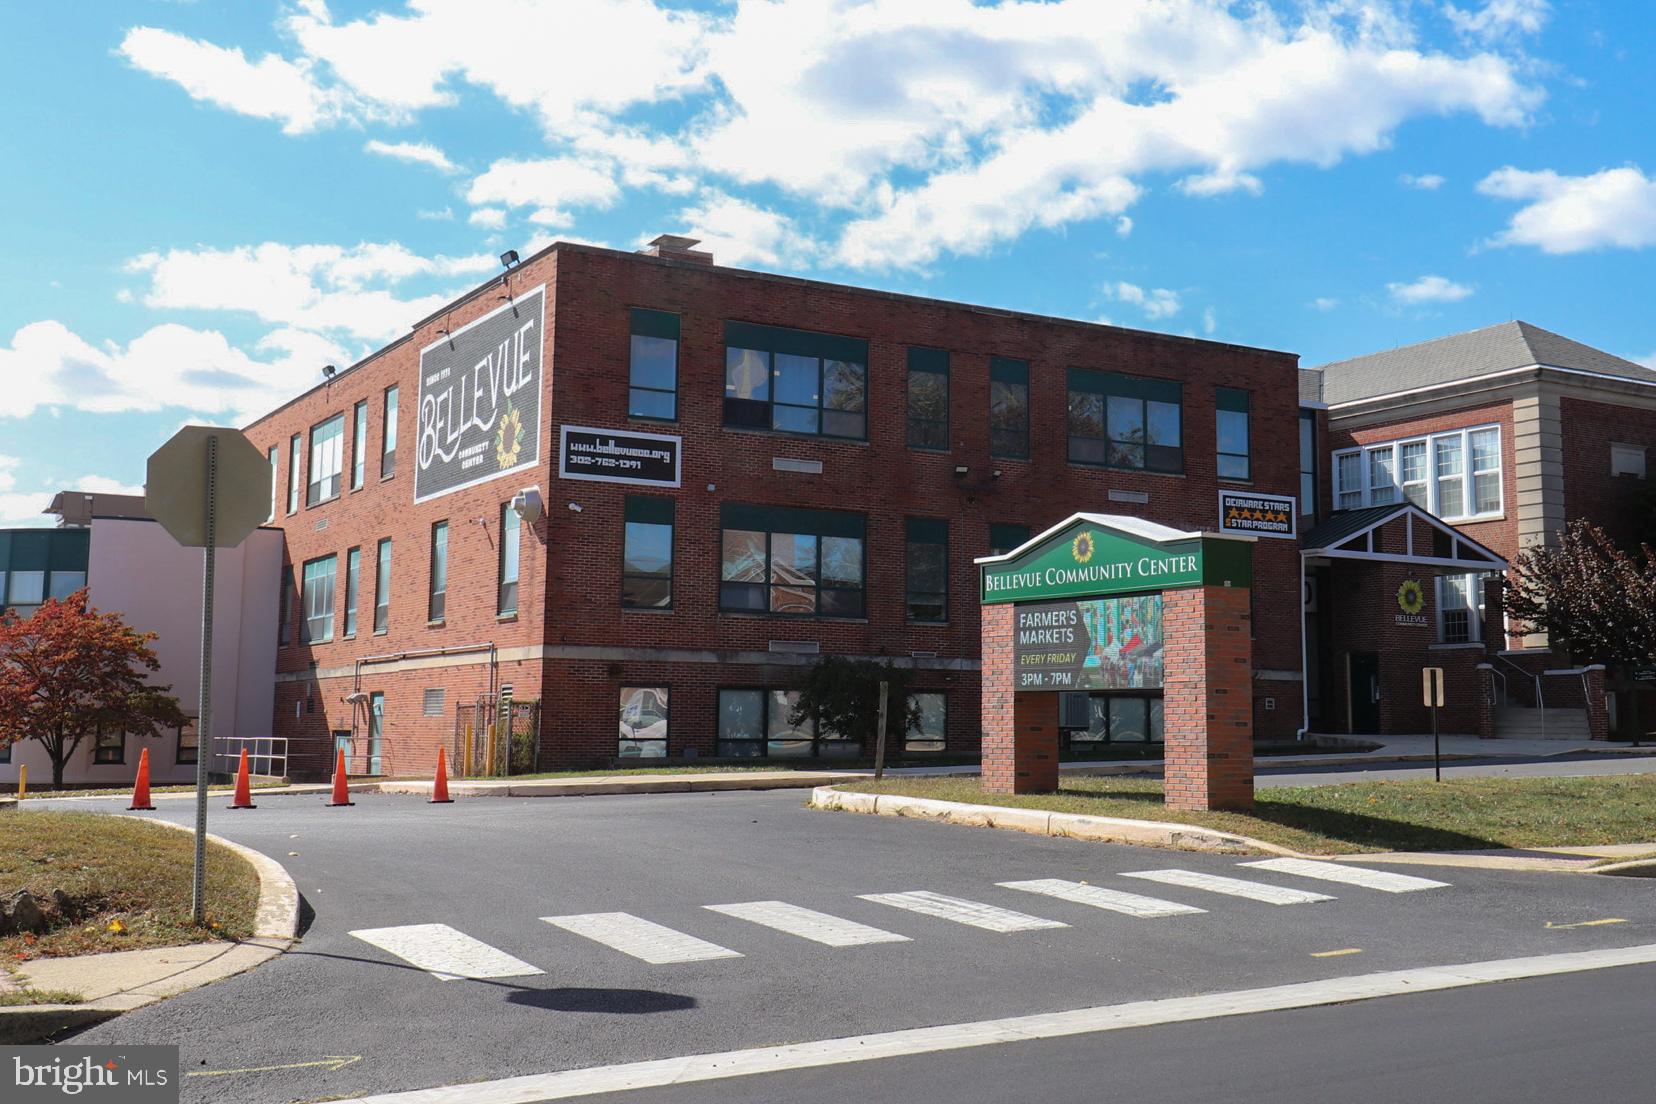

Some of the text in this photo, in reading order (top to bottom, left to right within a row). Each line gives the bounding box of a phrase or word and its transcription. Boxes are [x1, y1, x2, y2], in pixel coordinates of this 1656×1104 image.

[419, 318, 534, 470] BELLEVUE
[458, 440, 490, 459] COMMUNITY
[461, 454, 484, 470] CENTER
[569, 454, 641, 470] 302-762-1391
[1225, 497, 1290, 512] DELAWARE STARS
[1231, 518, 1252, 529] STAR
[1252, 521, 1289, 532] PROGRAM
[985, 555, 1198, 592] BELLEVUE COMMUNITY CENTER
[1019, 609, 1077, 628] FARMER'S
[1395, 614, 1428, 623] BELLEVUE
[1019, 627, 1075, 645] MARKETS
[1020, 651, 1078, 665] EVERY FRIDAY
[1021, 672, 1042, 687] 3PM
[1050, 671, 1072, 686] 7PM
